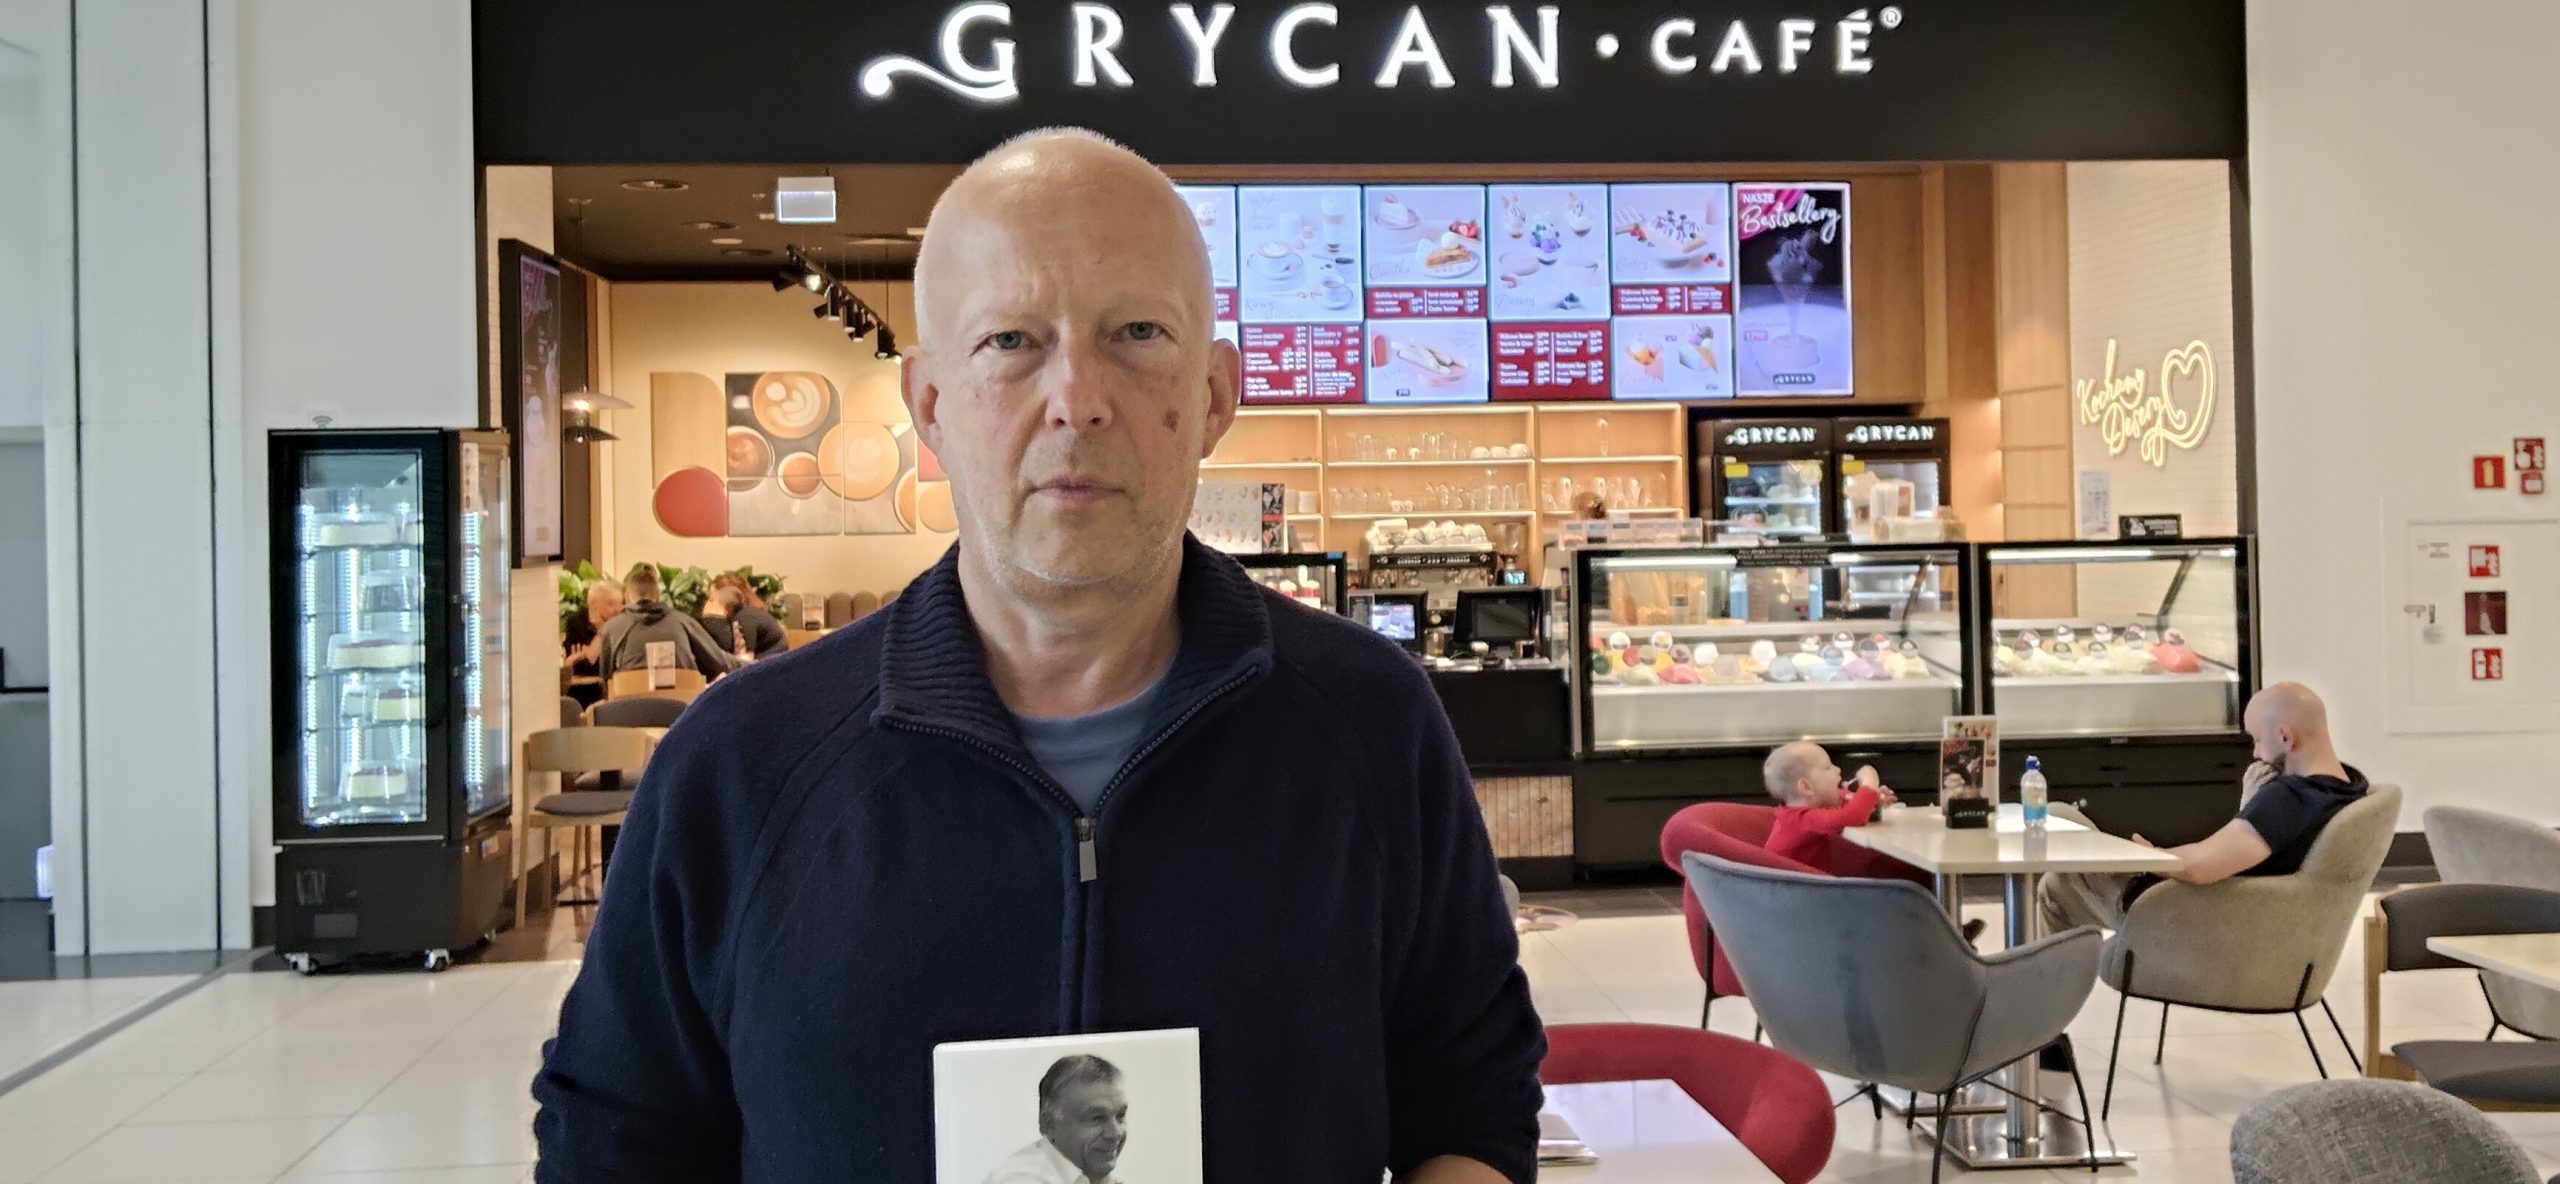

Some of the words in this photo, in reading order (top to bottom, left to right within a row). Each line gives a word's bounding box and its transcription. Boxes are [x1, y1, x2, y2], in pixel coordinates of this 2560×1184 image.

[862, 3, 1560, 99] GRYCAN
[1742, 192, 1776, 204] NASZE
[1741, 192, 1842, 245] Bestsellery
[1725, 426, 1817, 446] GRYCAN
[1846, 424, 1937, 444] GRYCAN
